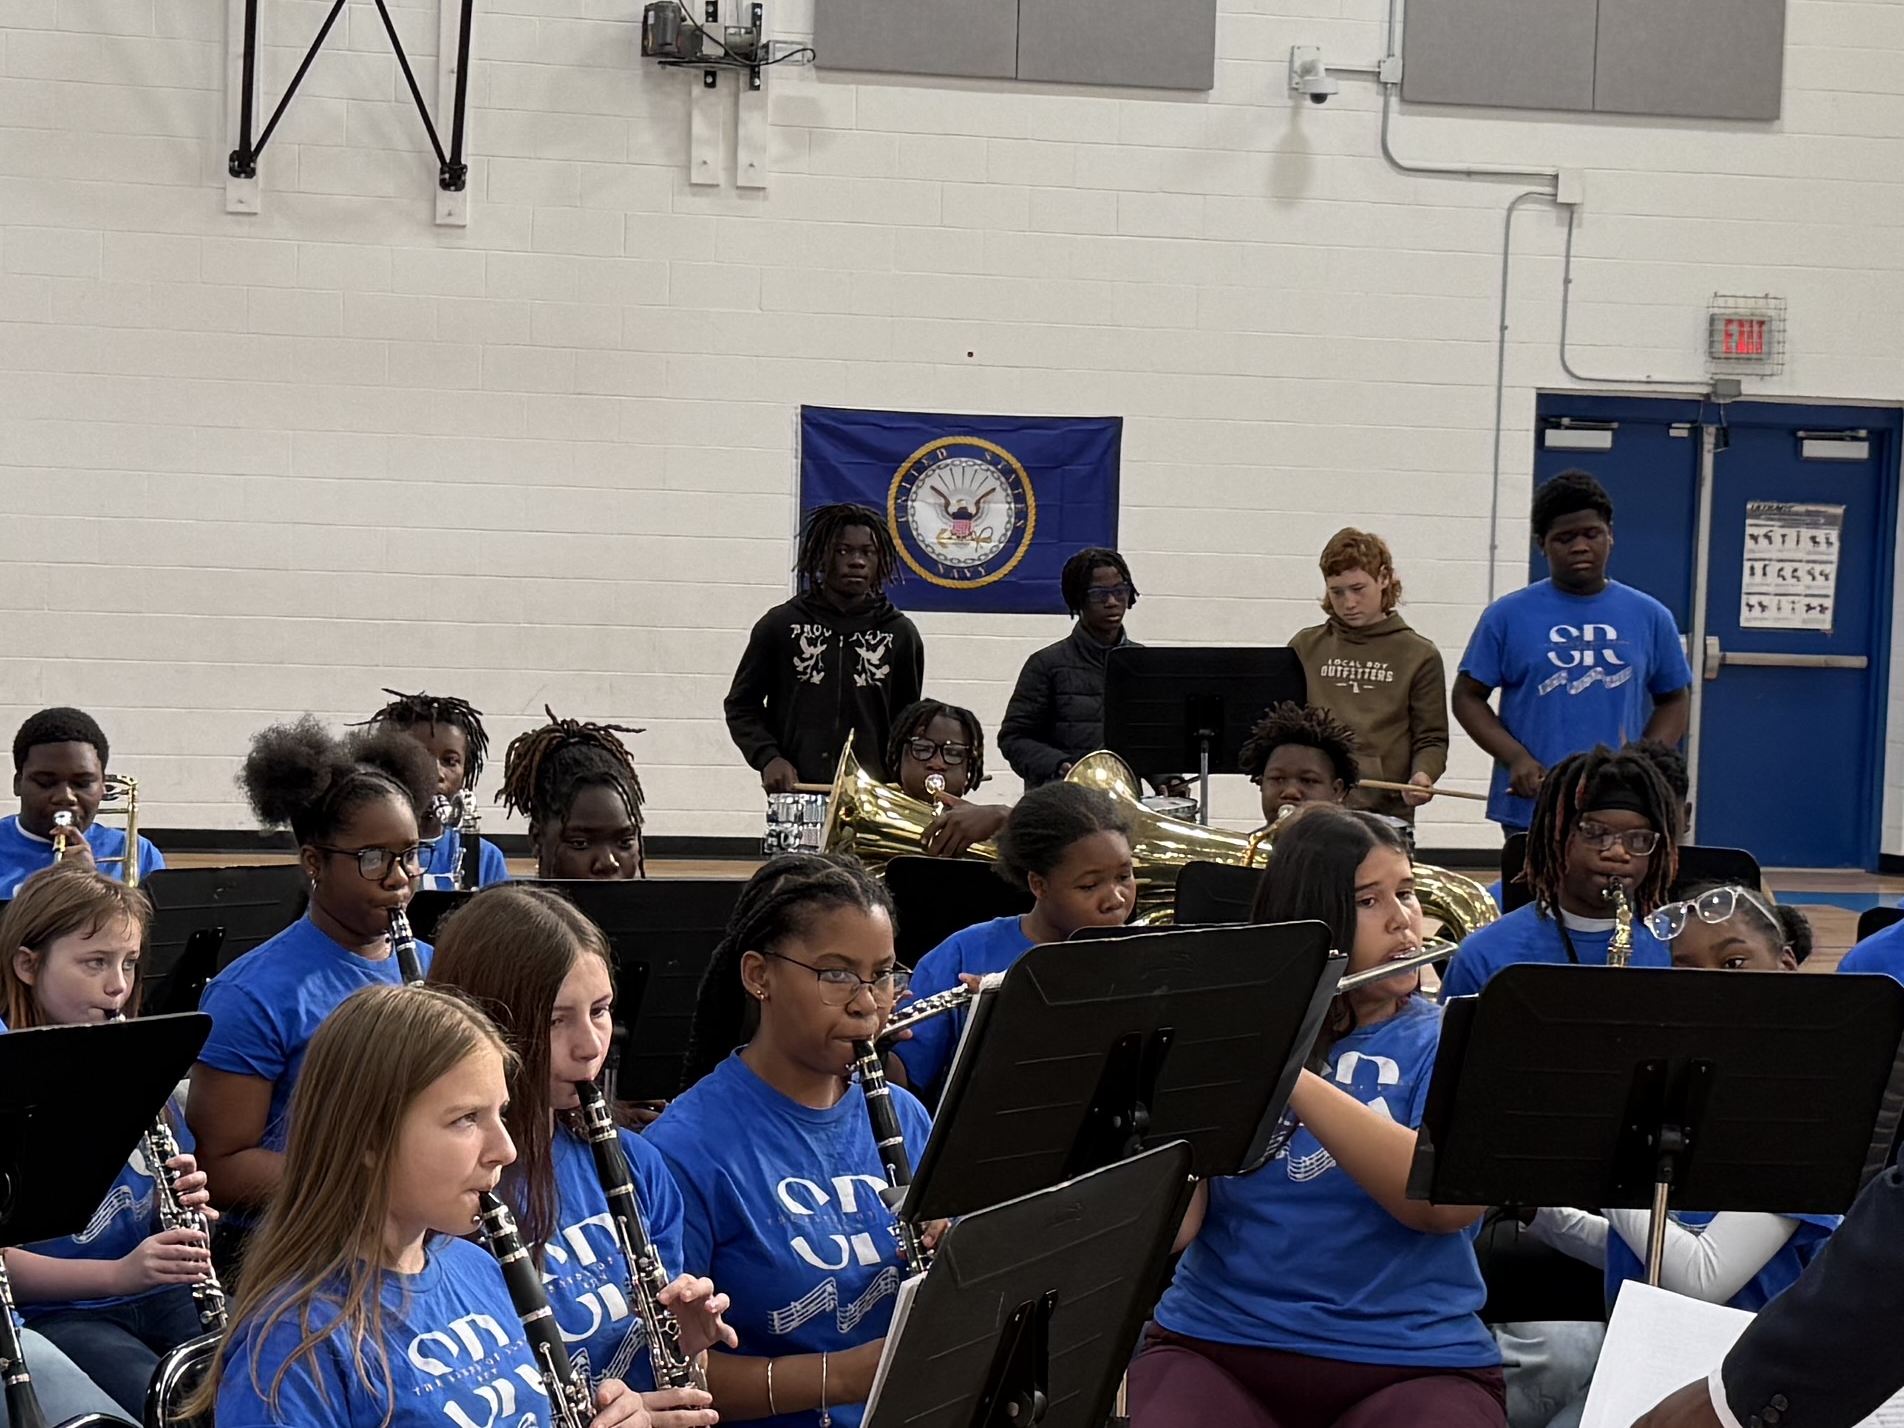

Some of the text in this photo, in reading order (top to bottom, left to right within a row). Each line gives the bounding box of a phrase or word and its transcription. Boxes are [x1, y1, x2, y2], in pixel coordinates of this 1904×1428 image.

[1723, 318, 1766, 355] EXIT
[1547, 623, 1625, 668] SR
[1320, 665, 1394, 682] OUTFITTERS
[1328, 658, 1362, 668] LOCAL
